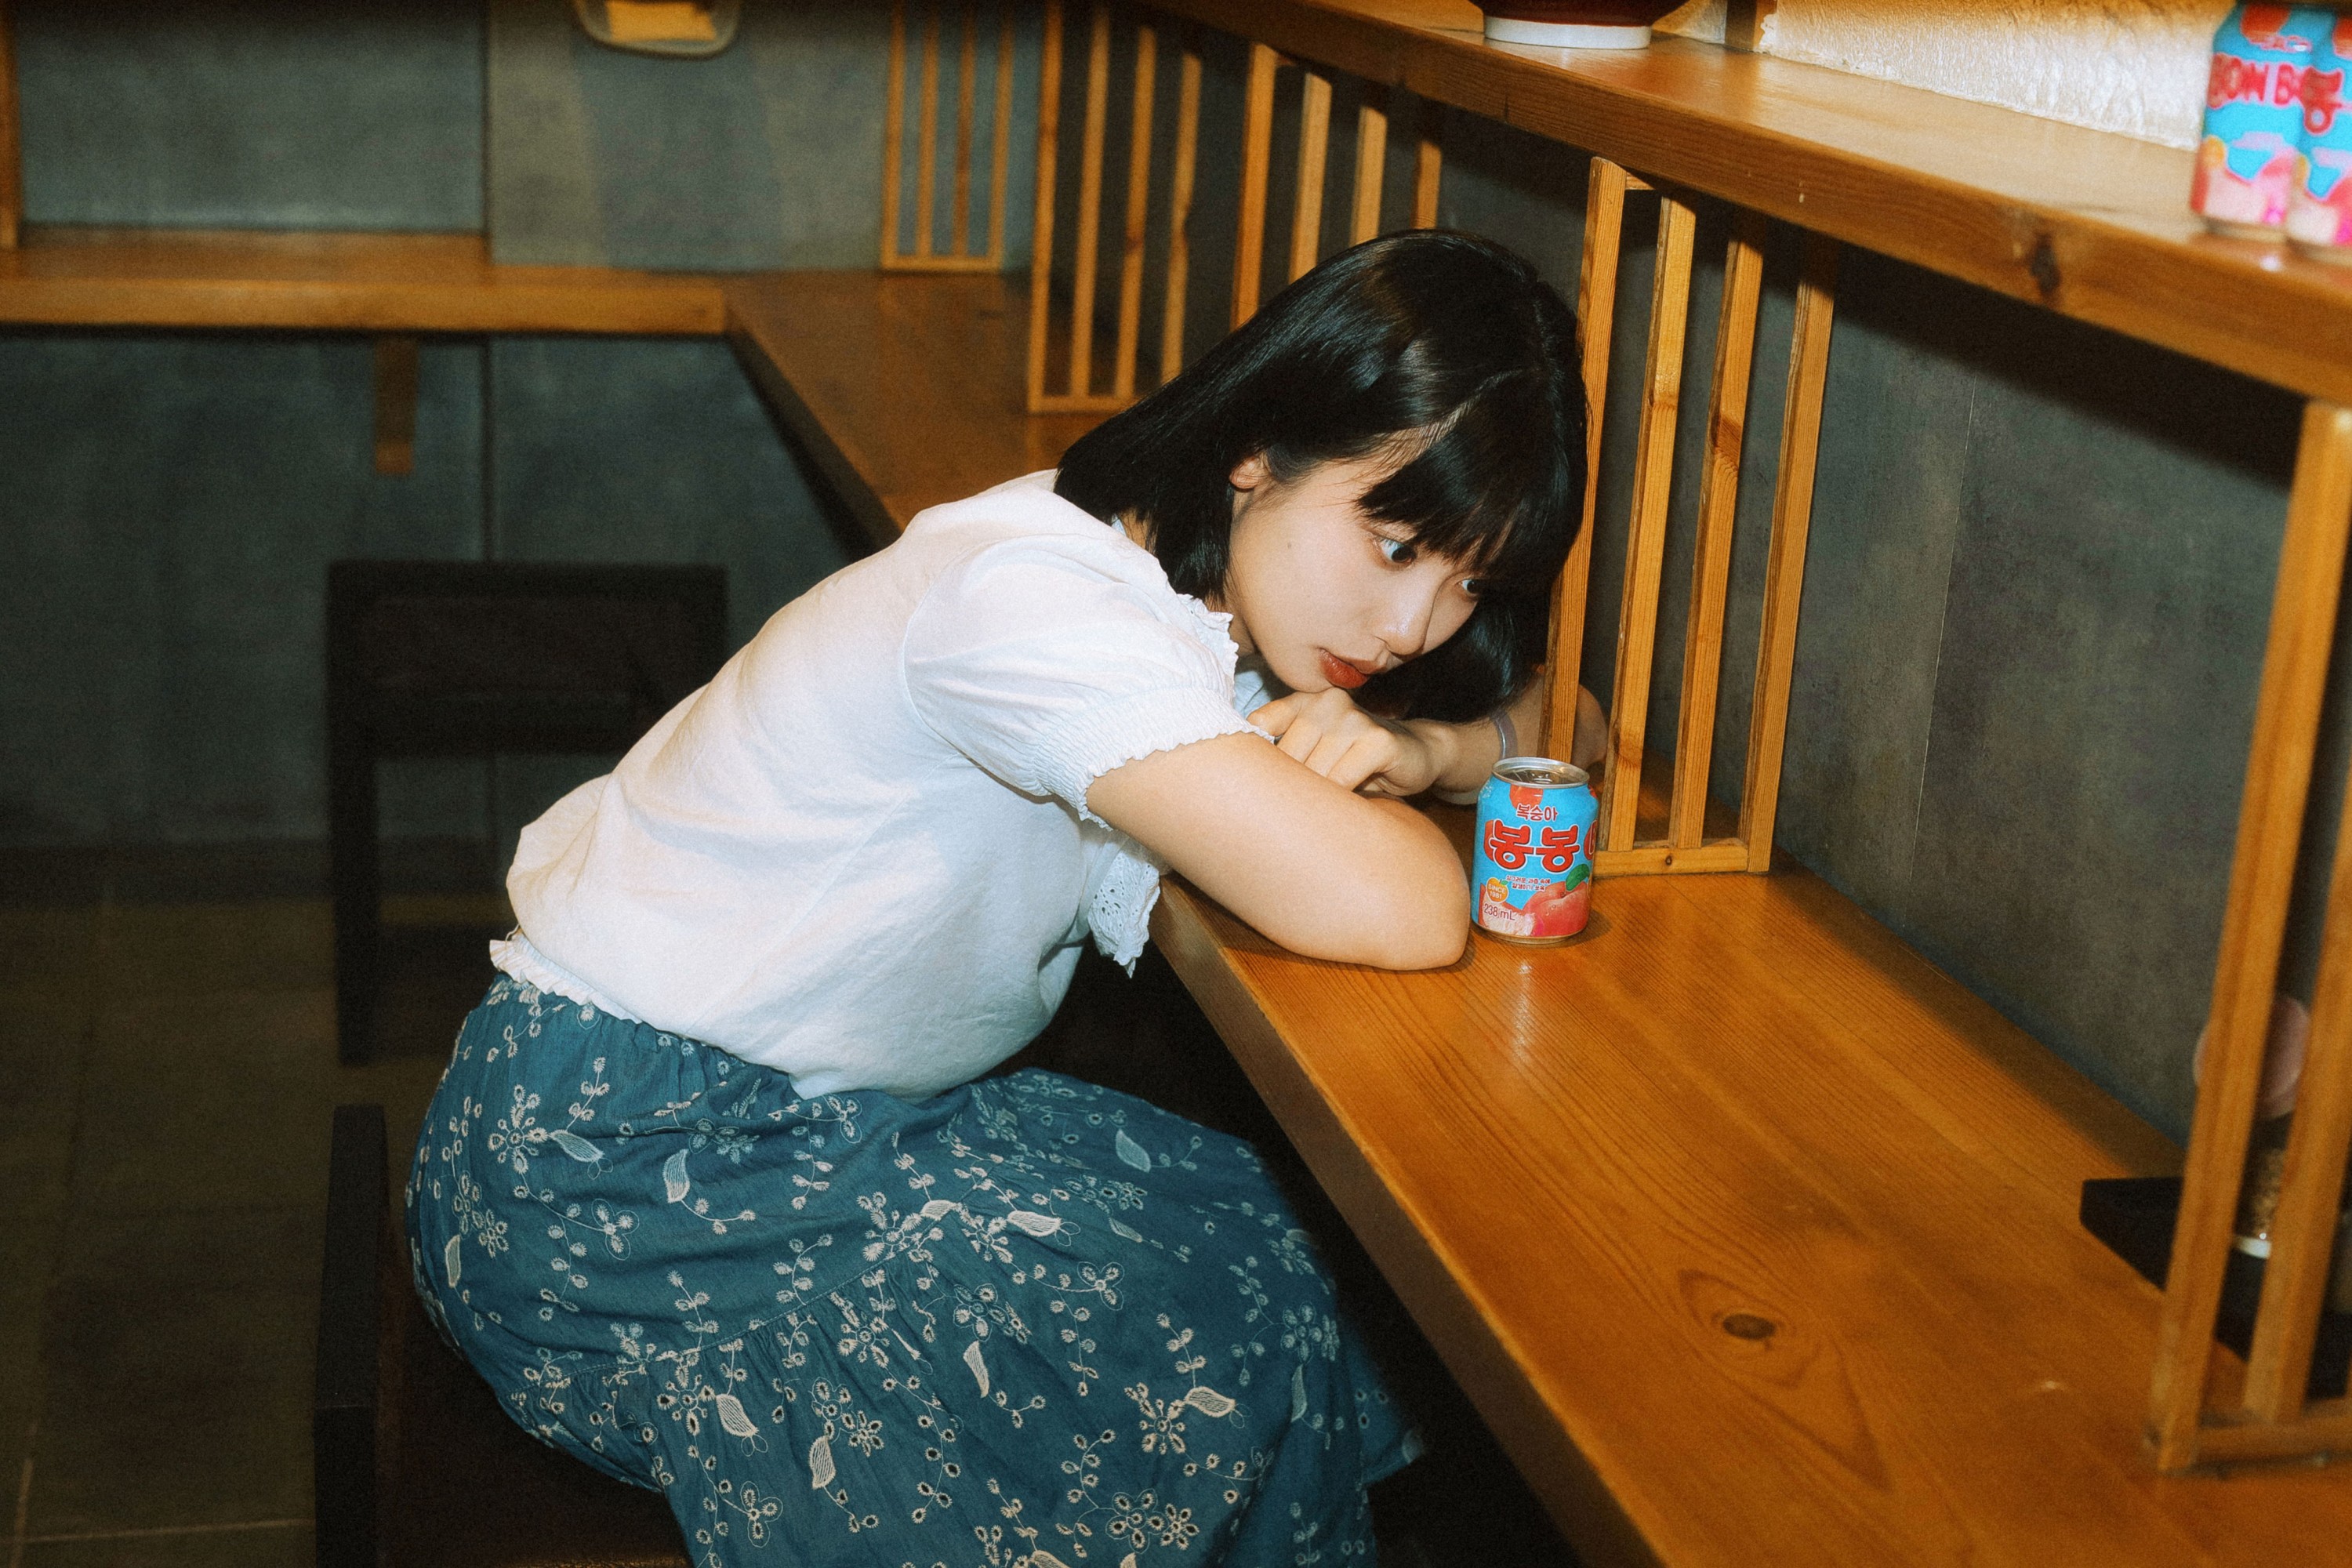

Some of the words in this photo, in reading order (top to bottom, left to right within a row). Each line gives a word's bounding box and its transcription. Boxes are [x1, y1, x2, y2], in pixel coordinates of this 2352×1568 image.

[2299, 66, 2345, 135] 봉
[1516, 804, 1558, 821] 복숭아
[1488, 818, 1581, 873] 봉봉
[1488, 884, 1506, 895] SINCE
[1490, 891, 1502, 900] 1981
[1483, 902, 1498, 917] 238
[1500, 909, 1515, 921] mL
